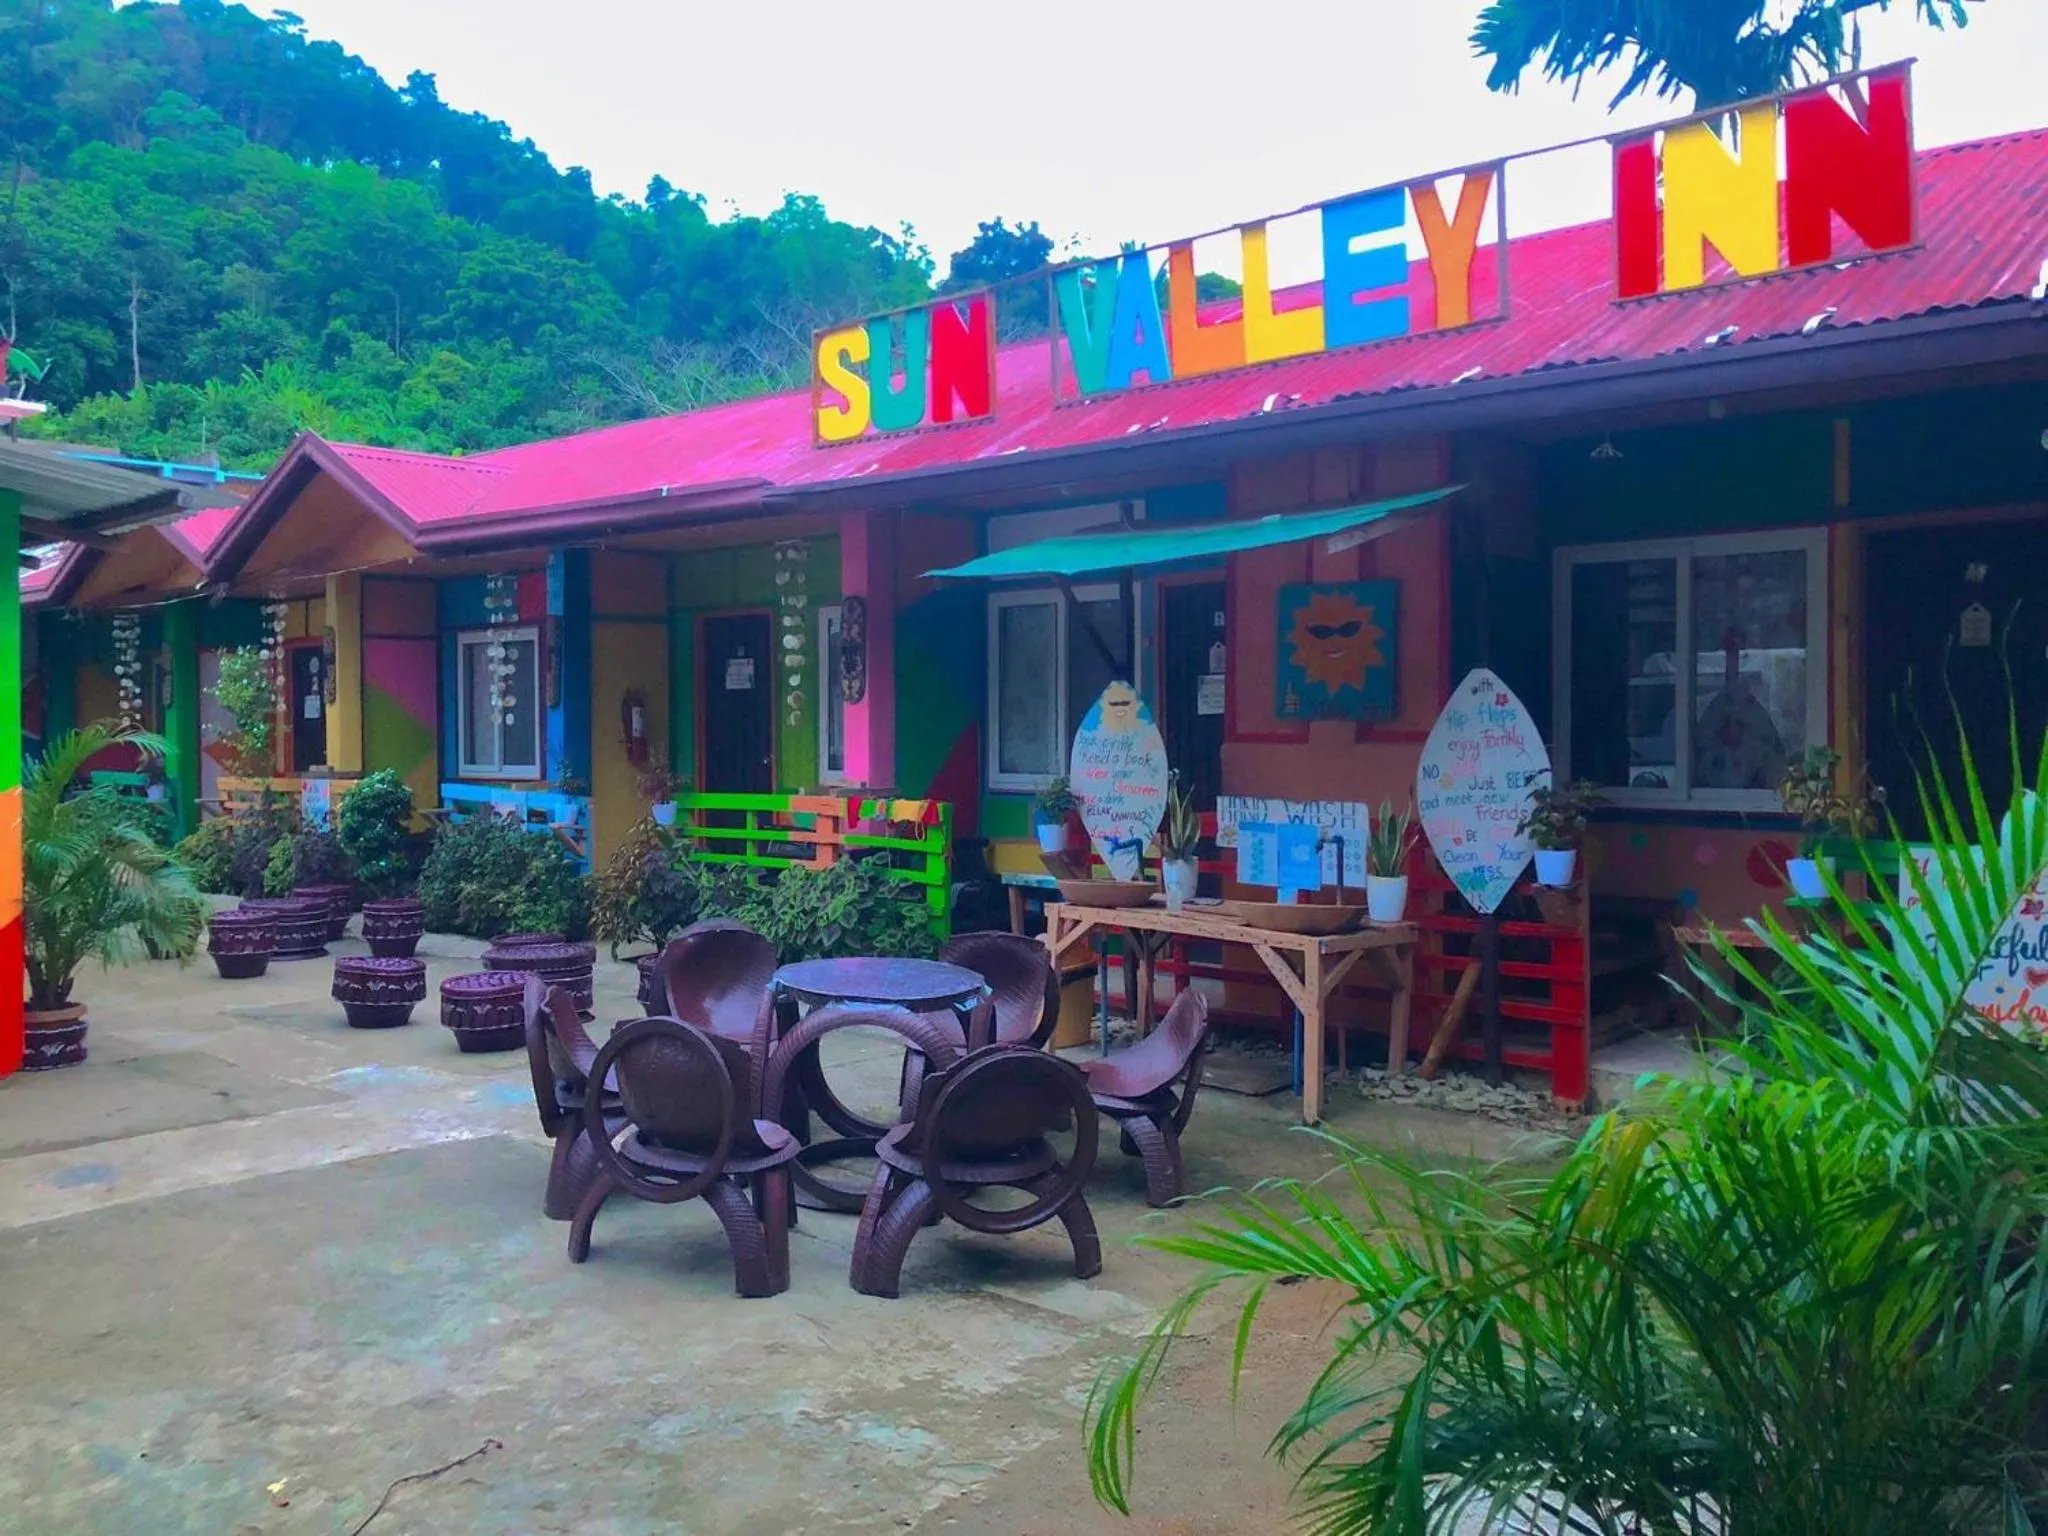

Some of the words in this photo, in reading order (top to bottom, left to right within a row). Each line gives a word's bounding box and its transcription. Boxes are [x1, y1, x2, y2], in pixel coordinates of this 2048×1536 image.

[817, 291, 991, 441] SUN
[1054, 169, 1495, 396] VALLEY
[1617, 74, 1912, 298] INN
[1471, 677, 1493, 696] with
[1478, 702, 1517, 728] flops
[1447, 738, 1480, 761] enjoy
[1422, 764, 1439, 780] NO
[1468, 776, 1496, 790] Just
[1221, 796, 1268, 823] HAND
[1284, 798, 1356, 830] WASH
[1466, 829, 1478, 842] BE
